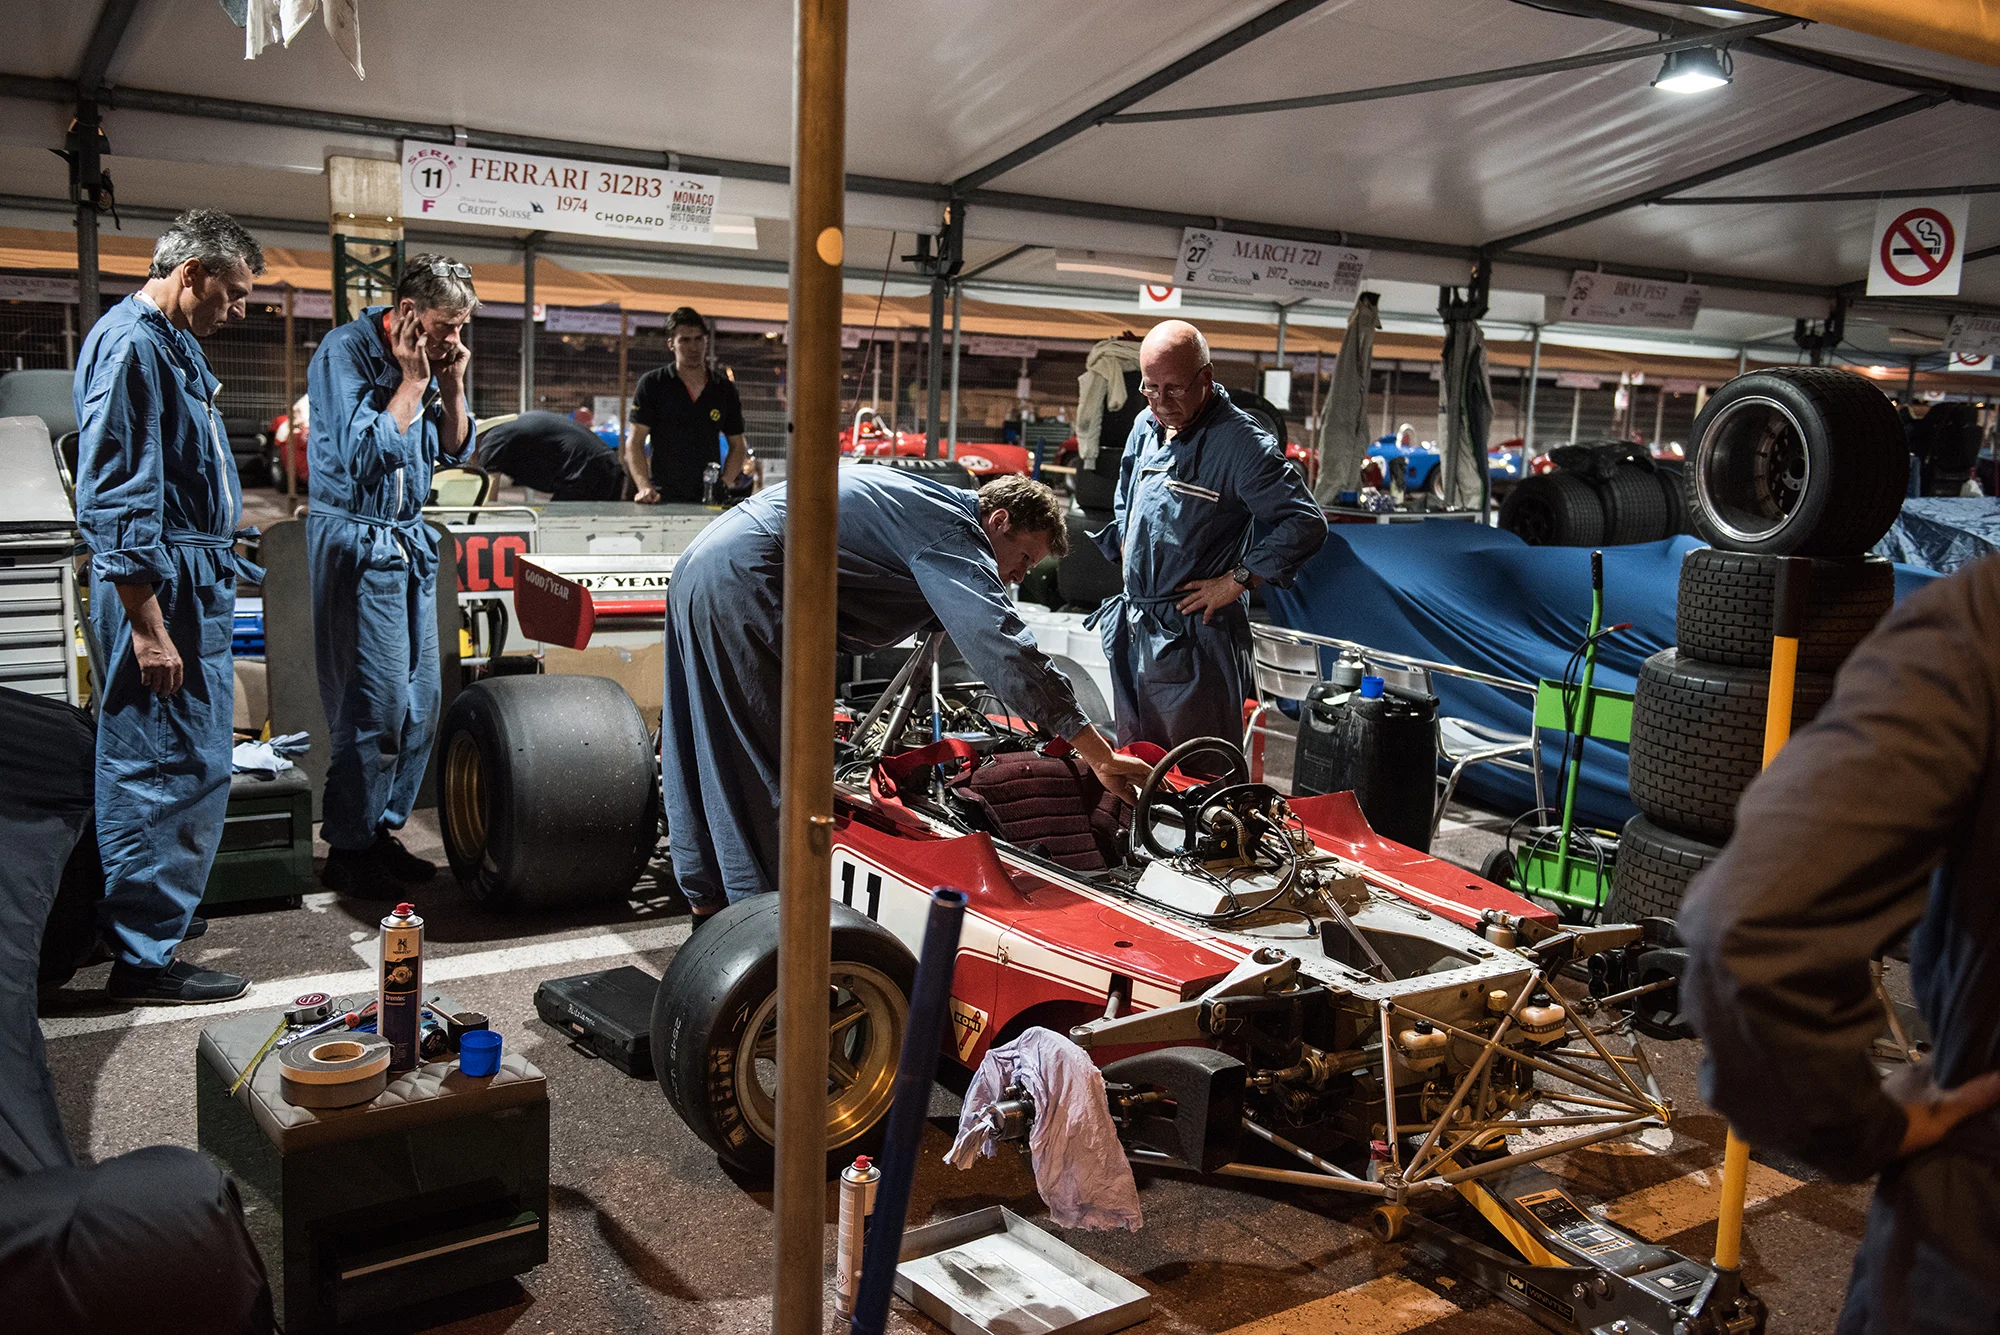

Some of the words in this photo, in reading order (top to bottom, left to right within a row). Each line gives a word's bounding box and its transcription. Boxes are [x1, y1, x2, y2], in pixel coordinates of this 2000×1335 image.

[407, 149, 457, 170] SERIE
[421, 167, 443, 189] 11
[470, 157, 589, 190] FERRARI
[597, 172, 662, 198] 312B3
[421, 199, 436, 213] F
[556, 195, 588, 213] 1974
[673, 191, 714, 207] MONACO
[457, 202, 496, 216] CREDIT
[498, 207, 532, 220] SUISSE
[595, 212, 664, 227] CHOPARD
[669, 213, 711, 225] HISTORIQUE
[1187, 246, 1206, 263] 27
[1233, 240, 1296, 263] MARCH
[1299, 248, 1322, 266] 721
[1186, 271, 1196, 281] E
[1266, 266, 1288, 280] 1972
[1288, 278, 1330, 289] CHOPARD
[841, 861, 882, 922] 11
[954, 1012, 980, 1032] KONI
